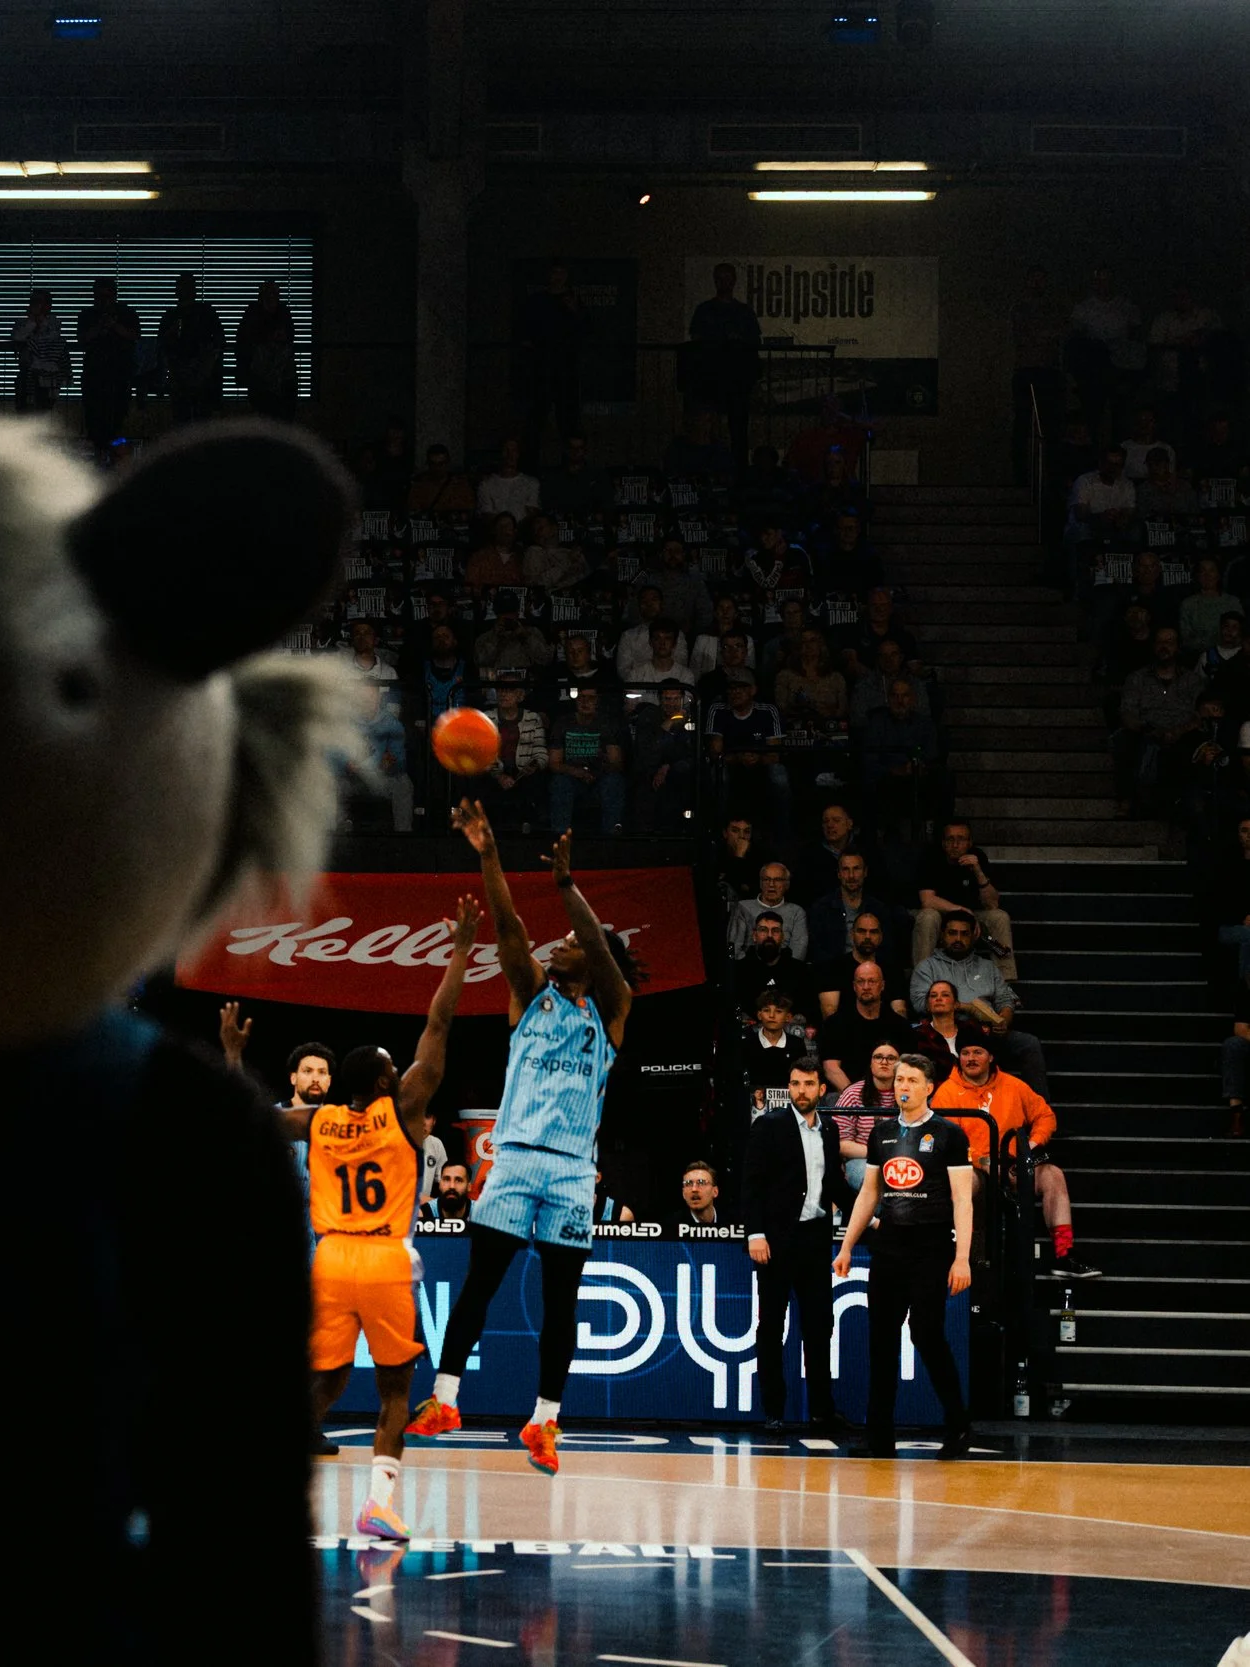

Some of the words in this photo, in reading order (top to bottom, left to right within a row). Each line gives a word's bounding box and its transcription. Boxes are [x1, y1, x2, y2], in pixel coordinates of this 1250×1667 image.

[582, 1026, 596, 1054] 2
[640, 1064, 703, 1073] POLICKE
[768, 1090, 791, 1100] STRAI
[335, 1161, 387, 1214] 16
[591, 1222, 662, 1237] rimeLED
[679, 1224, 745, 1239] PrimeLE
